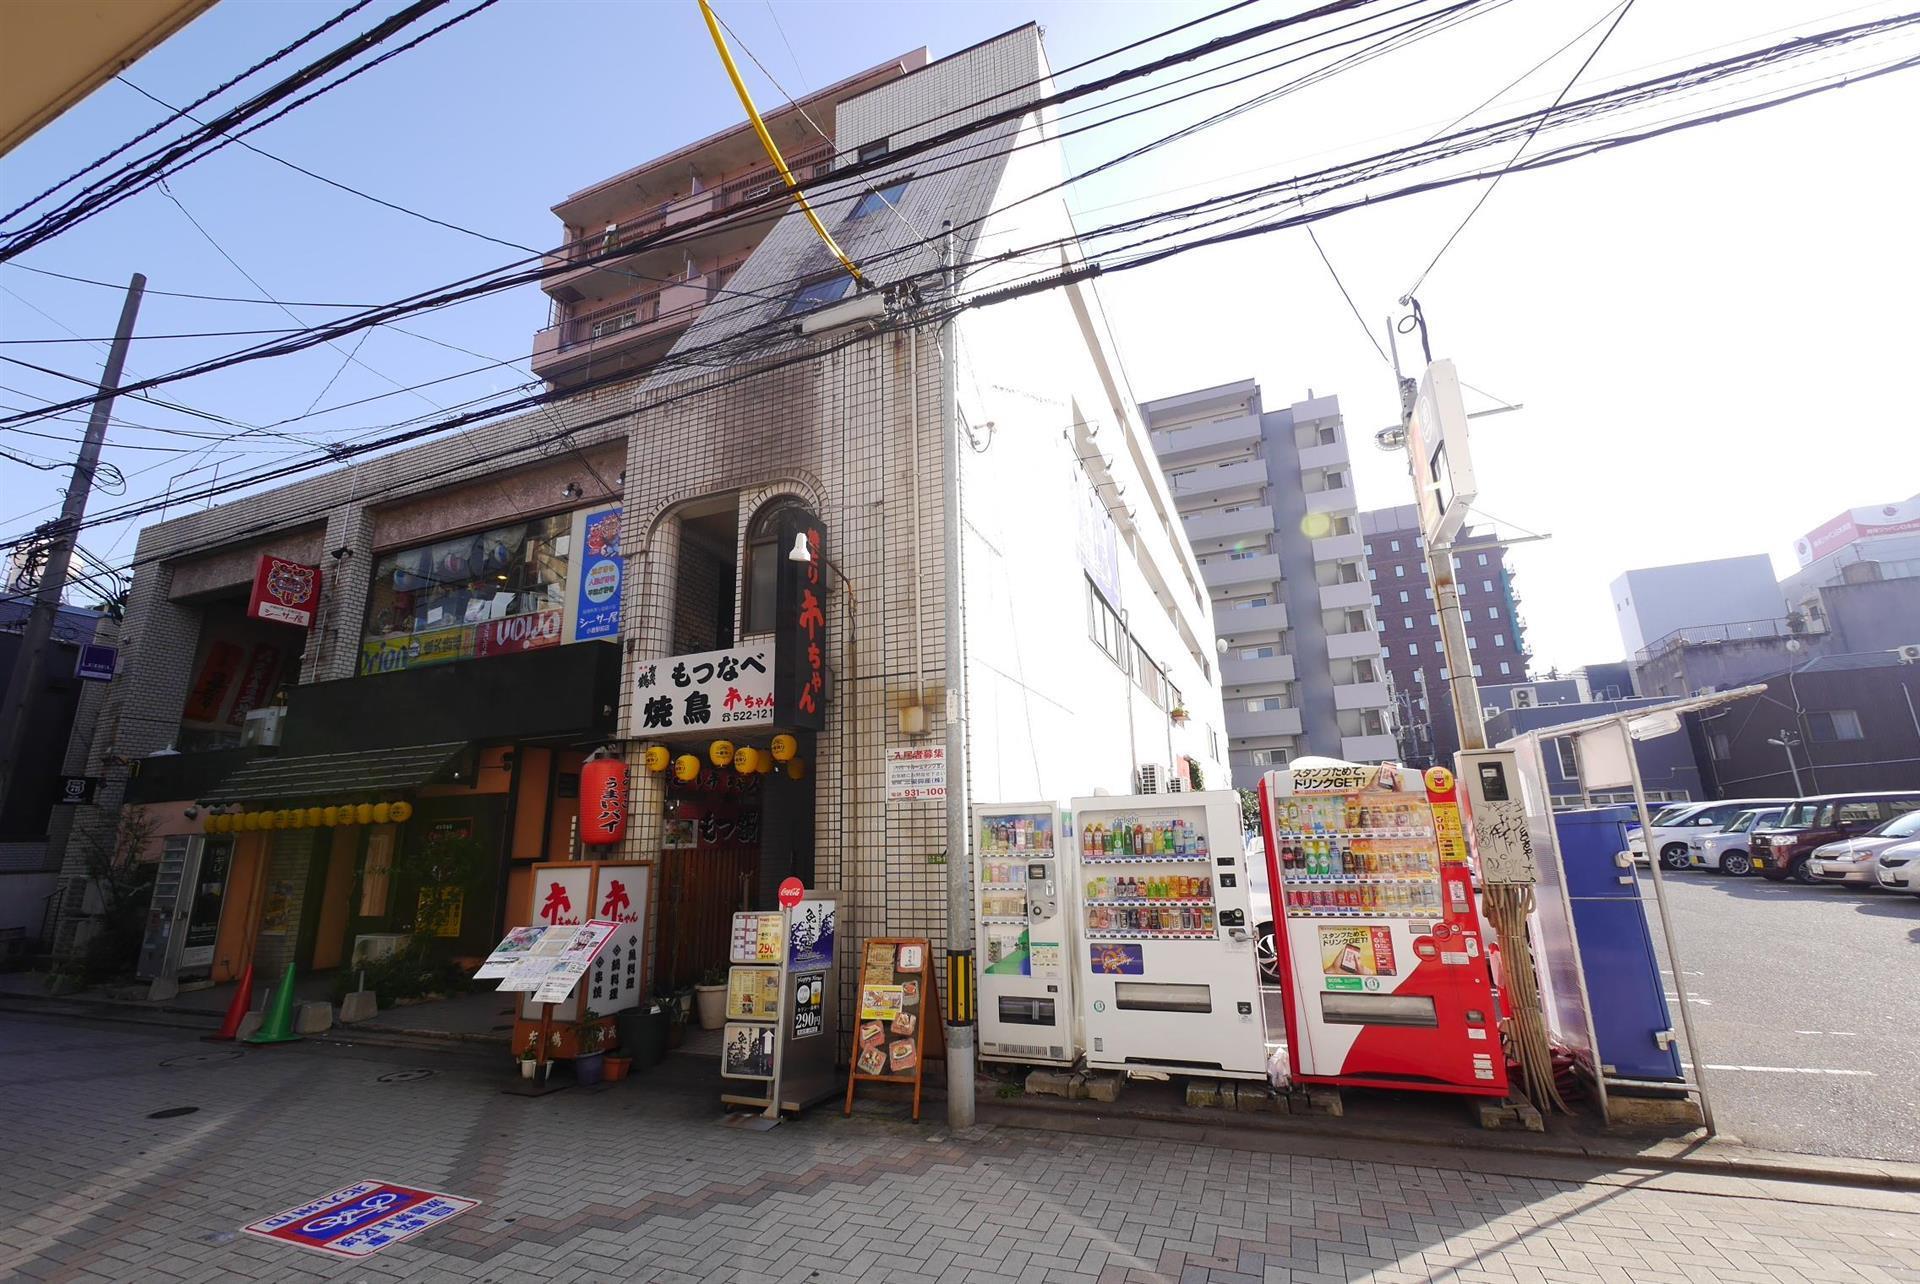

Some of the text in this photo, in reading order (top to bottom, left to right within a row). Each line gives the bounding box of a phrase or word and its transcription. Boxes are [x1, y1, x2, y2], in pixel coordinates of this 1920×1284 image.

[671, 653, 767, 688] もつなべ
[643, 691, 712, 728] 焼鳥
[1294, 777, 1366, 789] ドリンクGET!
[597, 777, 622, 834] うまいバイ
[265, 1184, 369, 1227] 北九州市
[336, 1198, 447, 1247] 放置禁止区域
[363, 1206, 456, 1247] 自転車
